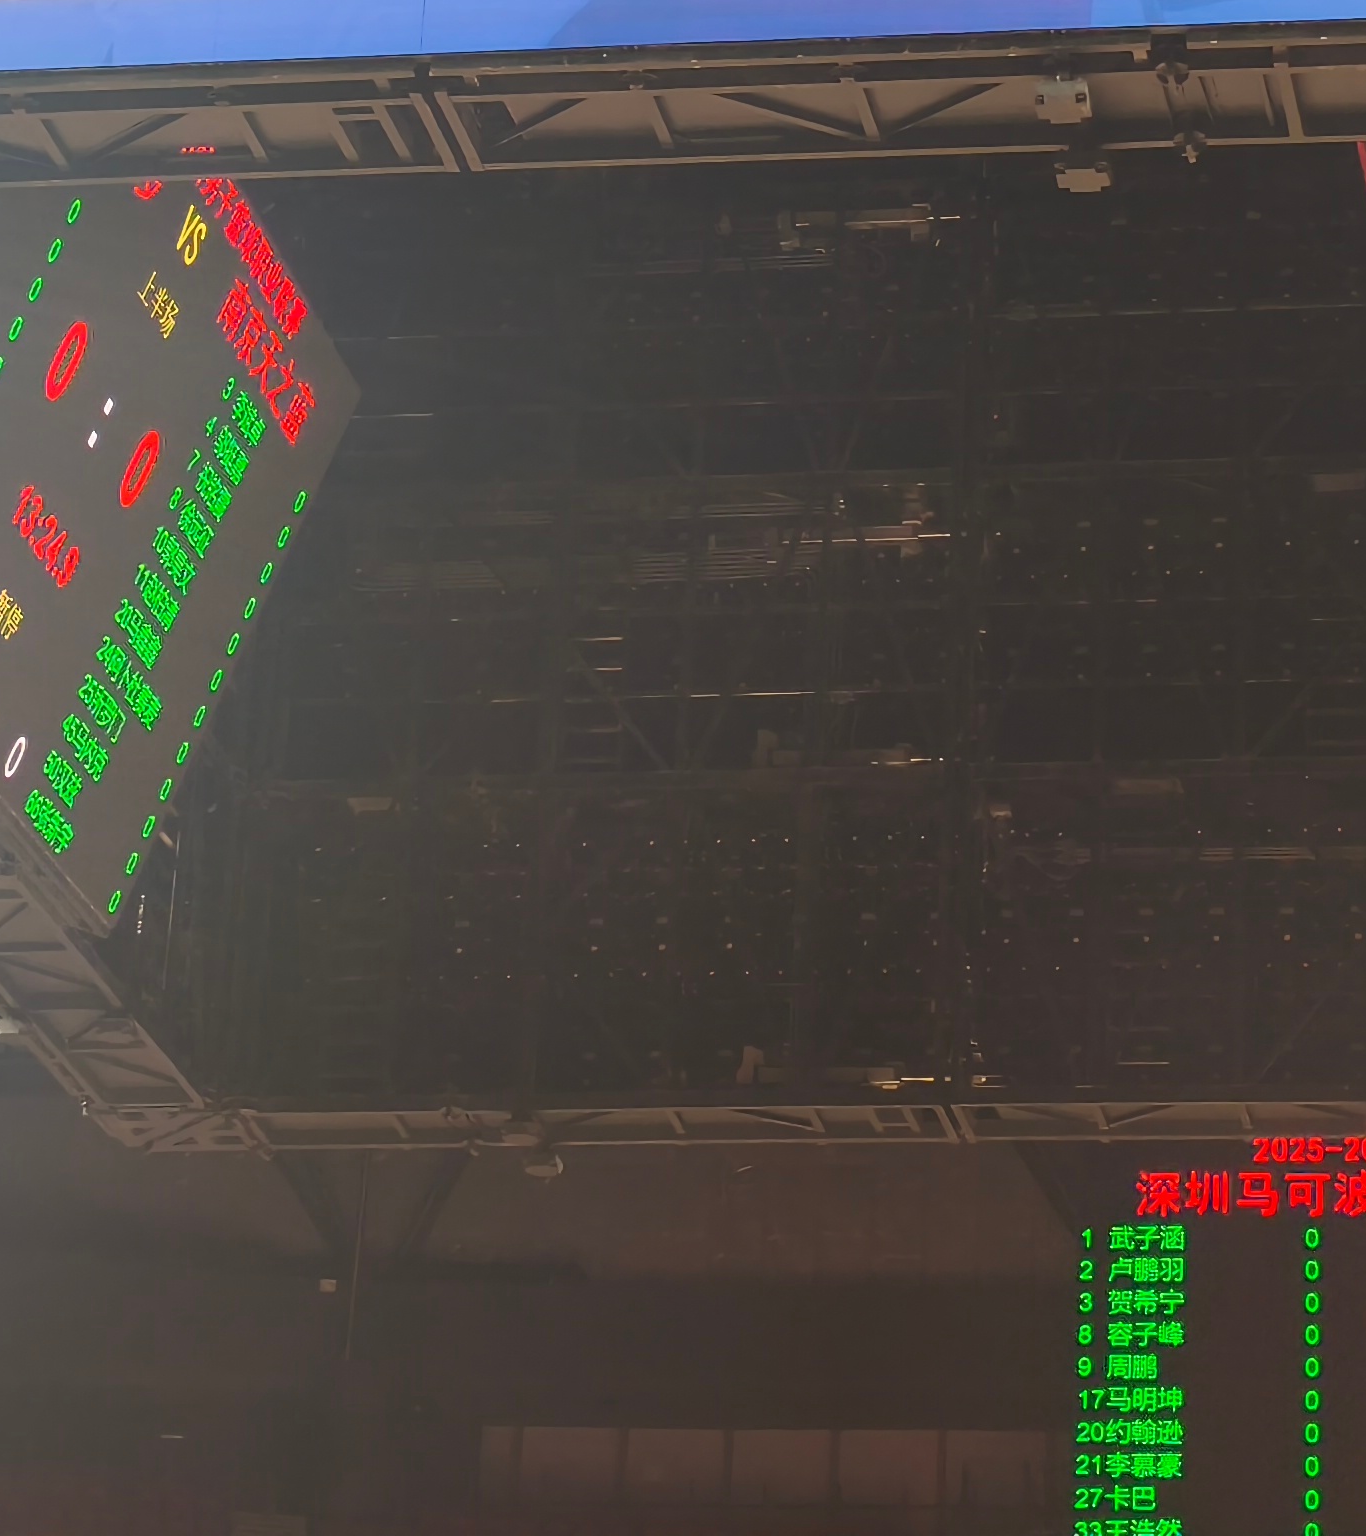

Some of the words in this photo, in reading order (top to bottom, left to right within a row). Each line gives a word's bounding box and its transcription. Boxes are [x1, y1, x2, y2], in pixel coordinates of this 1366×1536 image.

[66, 199, 82, 225] 0
[176, 204, 207, 266] VS
[46, 238, 64, 265] 0
[27, 277, 45, 304] 0
[137, 271, 180, 339] 上半场
[8, 316, 25, 344] 0
[218, 279, 316, 446] 南京天之蓝
[221, 377, 237, 402] 3
[46, 321, 88, 402] 0
[120, 430, 160, 508] 0
[205, 416, 218, 437] 4
[188, 449, 203, 470] 7
[168, 486, 185, 512] 8
[293, 490, 309, 514] 0
[12, 486, 80, 588] 13:24.9
[277, 526, 292, 549] 0
[260, 563, 273, 585] 0
[243, 598, 257, 620] 0
[226, 632, 240, 656] 0
[209, 669, 225, 692] 0
[192, 705, 207, 729] 0
[4, 736, 26, 778] 0
[176, 741, 190, 766] 0
[158, 778, 173, 802] 0
[142, 815, 156, 839] 0
[125, 851, 141, 875] 0
[108, 890, 122, 914] 0
[1082, 1228, 1092, 1248] 1
[1109, 1224, 1185, 1251] 武子涵
[1305, 1228, 1320, 1249] 0
[1079, 1260, 1093, 1281] 2
[1108, 1256, 1184, 1283] 卢鹏羽
[1305, 1260, 1320, 1281] 0
[1079, 1292, 1093, 1313] 3
[1108, 1288, 1185, 1315] 贺希宁
[1305, 1292, 1320, 1313] 0
[1078, 1324, 1092, 1345] 8
[1107, 1320, 1185, 1347] 容子峰
[1305, 1324, 1320, 1346] 0
[1077, 1356, 1092, 1377] 9
[1106, 1353, 1158, 1380] 周鹏
[1304, 1357, 1320, 1378] 0
[1079, 1386, 1183, 1413] 17马明坤
[1304, 1390, 1320, 1411] 0
[1076, 1418, 1184, 1445] 20约翰逊
[1304, 1423, 1320, 1444] 0
[1304, 1455, 1320, 1477] 0
[1074, 1484, 1157, 1512] 27卡巴
[1304, 1489, 1320, 1510] 0
